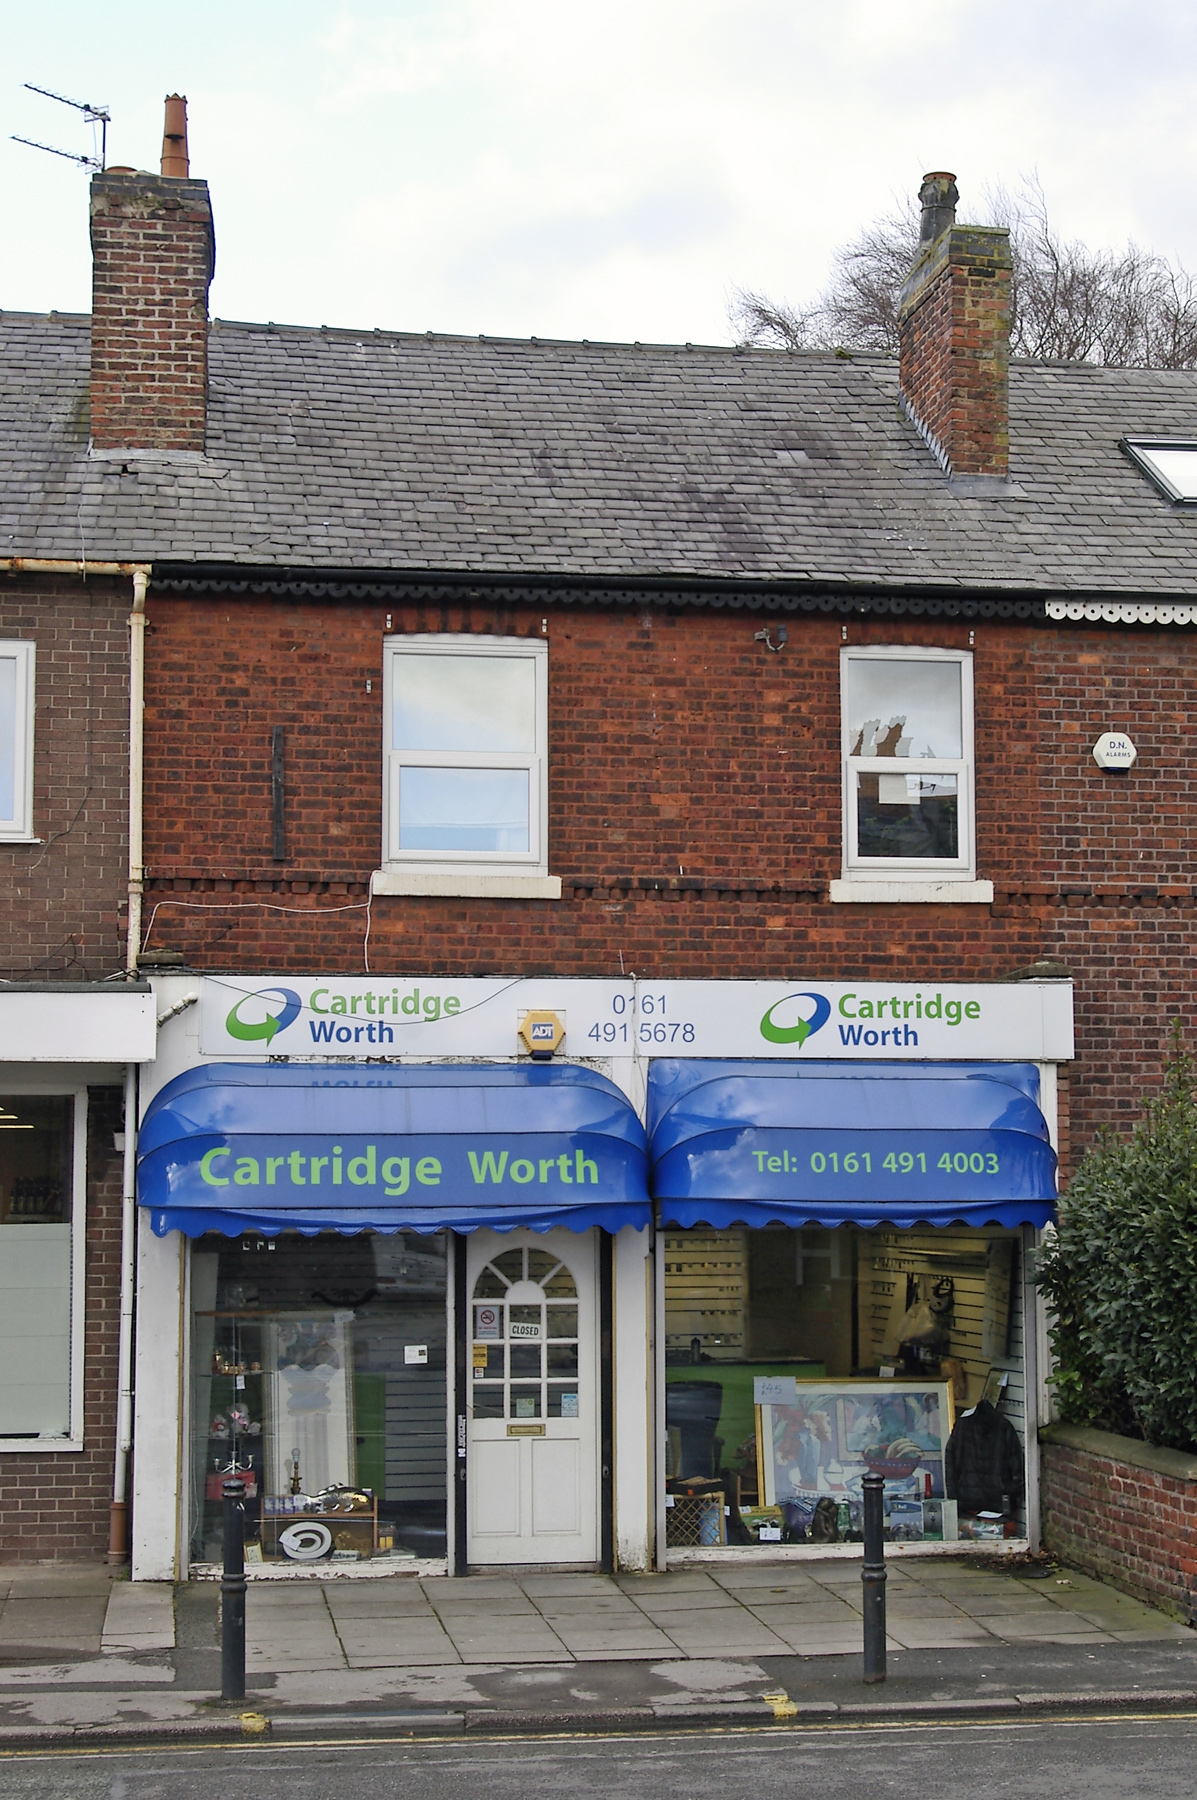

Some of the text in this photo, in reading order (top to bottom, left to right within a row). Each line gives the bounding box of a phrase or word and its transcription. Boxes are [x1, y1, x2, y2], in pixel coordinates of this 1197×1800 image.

[1109, 741, 1127, 749] D.N.
[309, 988, 461, 1022] Cartridge
[612, 994, 667, 1015] 0161
[838, 993, 981, 1026] Cartridge
[310, 1020, 394, 1043] Worth
[532, 1026, 554, 1037] ADT
[588, 1023, 696, 1043] 491 5678
[838, 1024, 919, 1046] Worth
[200, 1146, 599, 1196] Cartridge Worth
[752, 1151, 1000, 1174] Tel: 0161 491 4003
[511, 1324, 540, 1336] CLOSED
